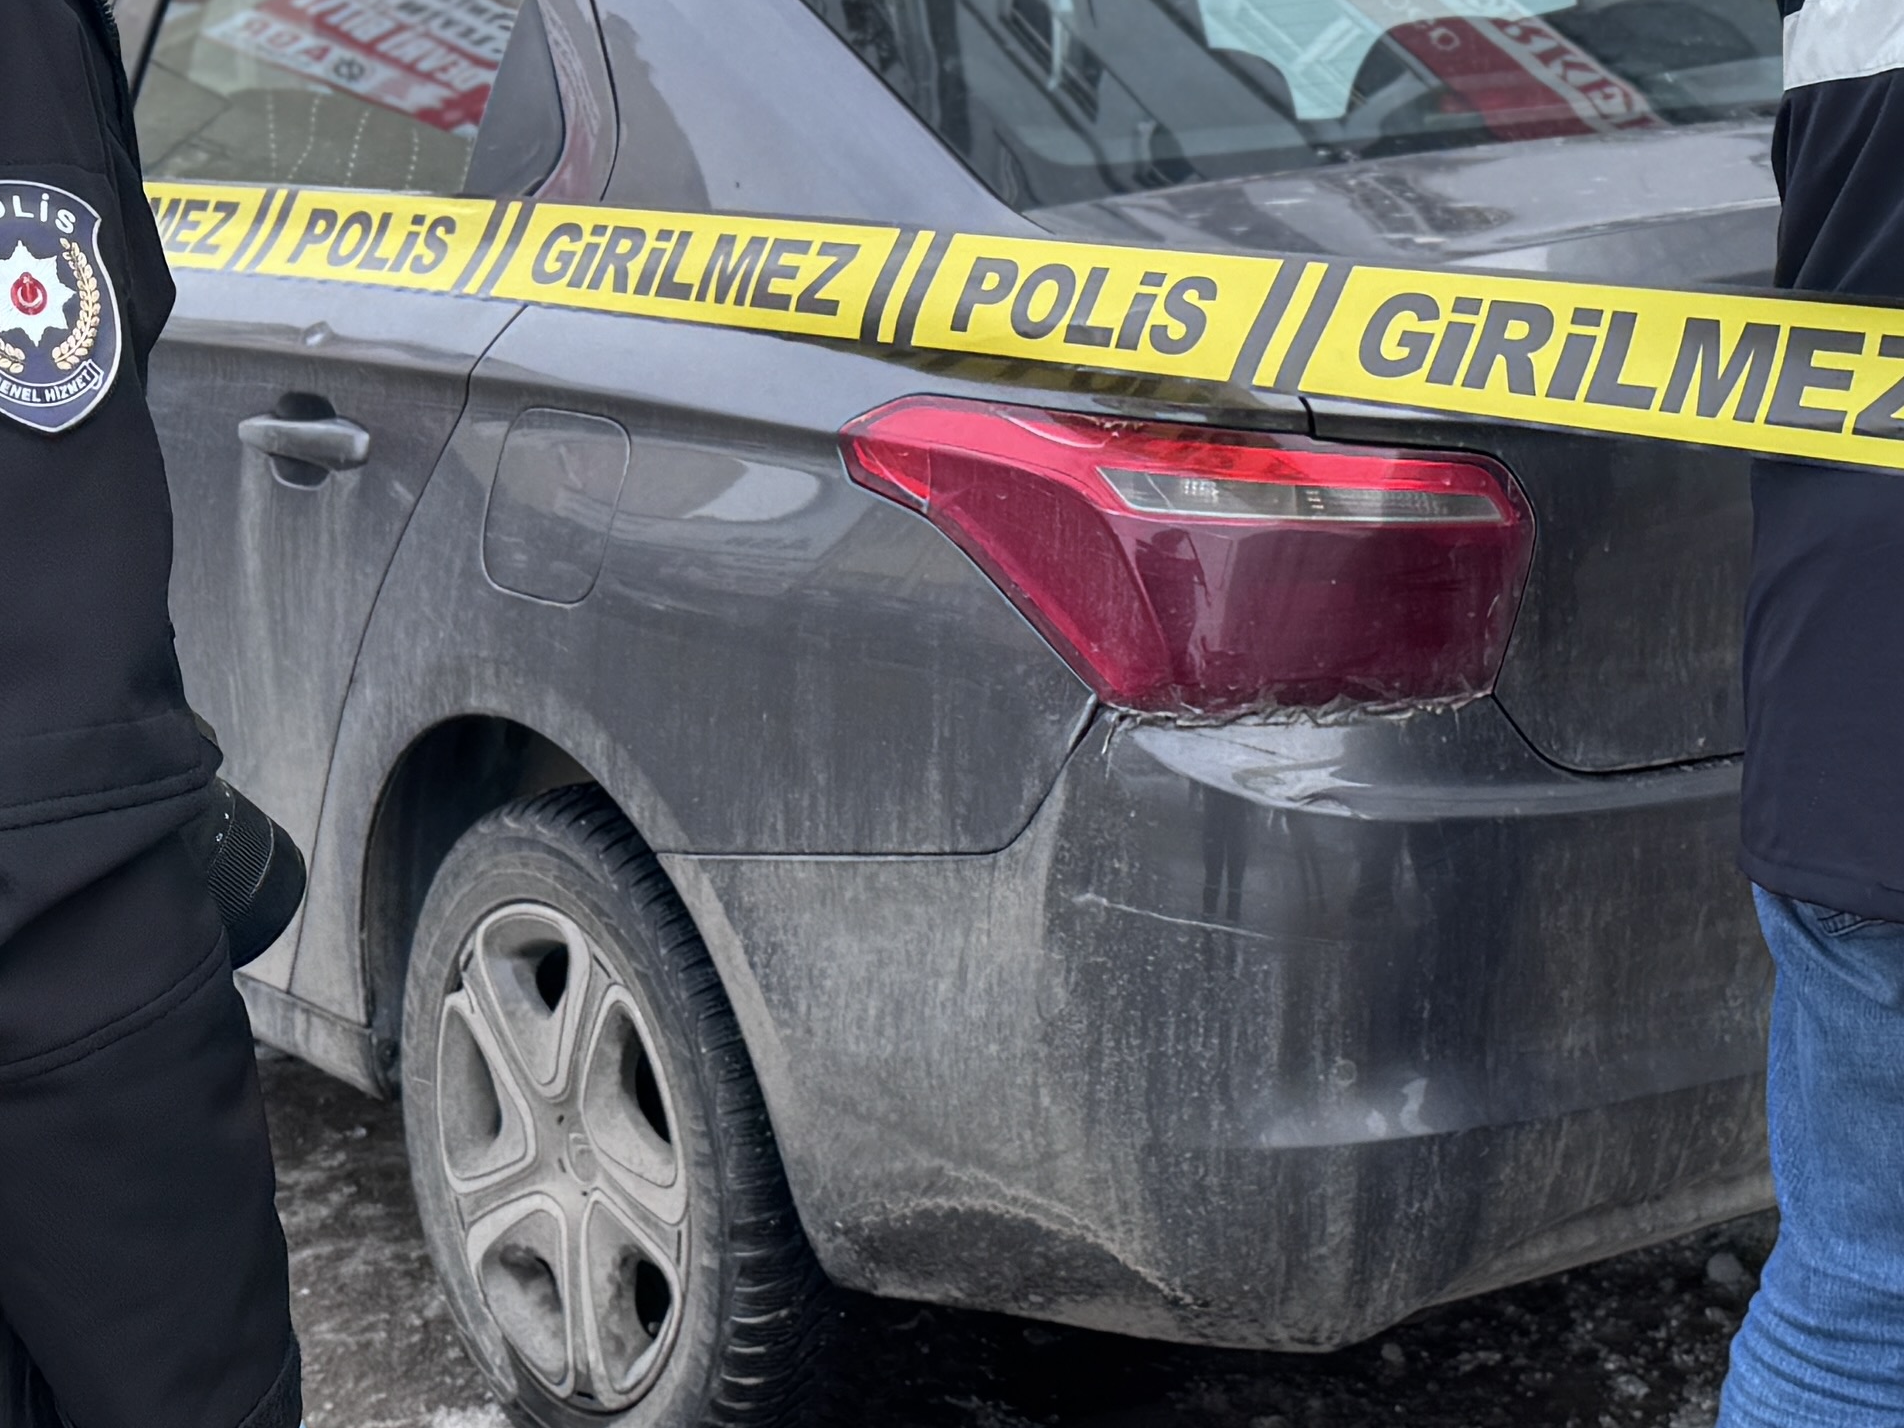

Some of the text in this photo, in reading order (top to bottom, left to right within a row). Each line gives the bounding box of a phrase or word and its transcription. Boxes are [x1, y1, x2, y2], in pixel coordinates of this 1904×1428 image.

[286, 208, 457, 275] POLİS
[533, 222, 863, 317] GİRİLMEZ
[949, 255, 1219, 356] POLİS
[44, 369, 93, 402] HİZMET
